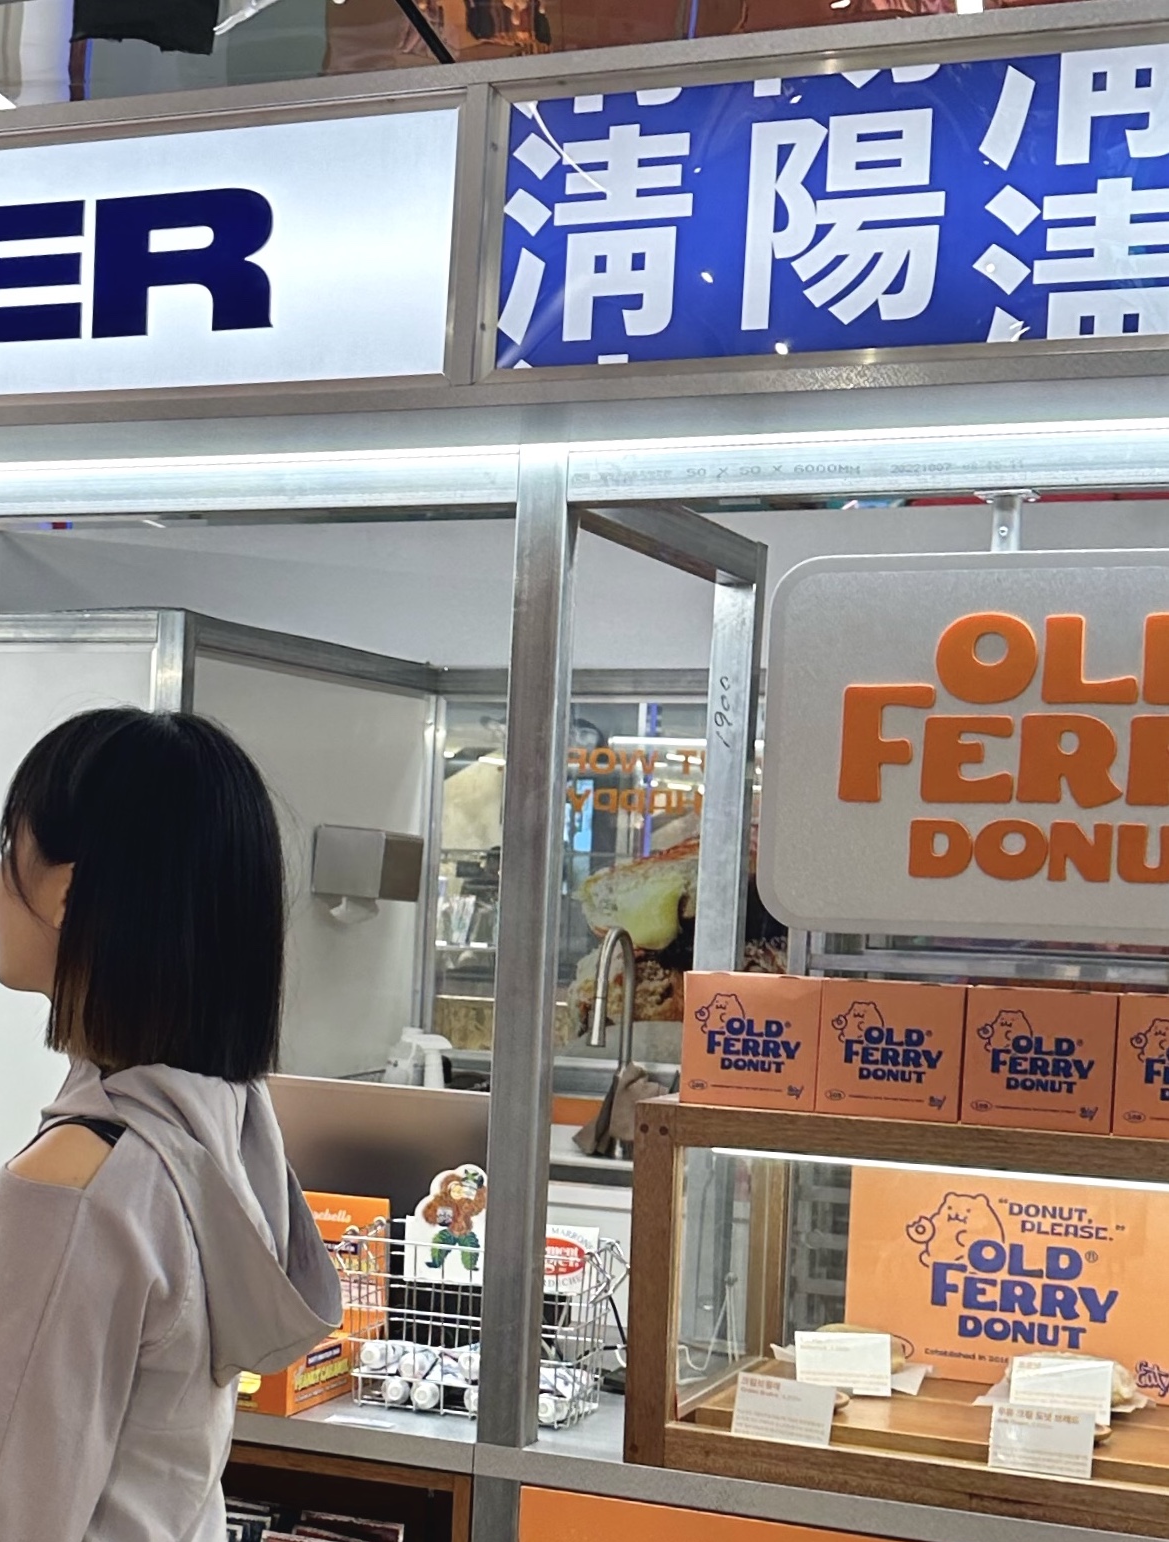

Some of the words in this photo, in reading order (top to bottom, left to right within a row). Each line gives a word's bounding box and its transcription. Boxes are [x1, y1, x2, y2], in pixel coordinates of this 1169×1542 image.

[725, 1017, 784, 1039] OLD
[864, 1026, 925, 1048] OLD
[706, 1029, 801, 1060] FERRY
[844, 1038, 943, 1069] FERRY
[1011, 1035, 1076, 1057] OLD
[720, 1057, 786, 1074] DONUT
[991, 1048, 1094, 1080] FERRY
[858, 1067, 927, 1084] DONUT
[1005, 1076, 1078, 1095] DONUT
[930, 1260, 1120, 1324] FERRY
[957, 1314, 1087, 1350] DONUT
